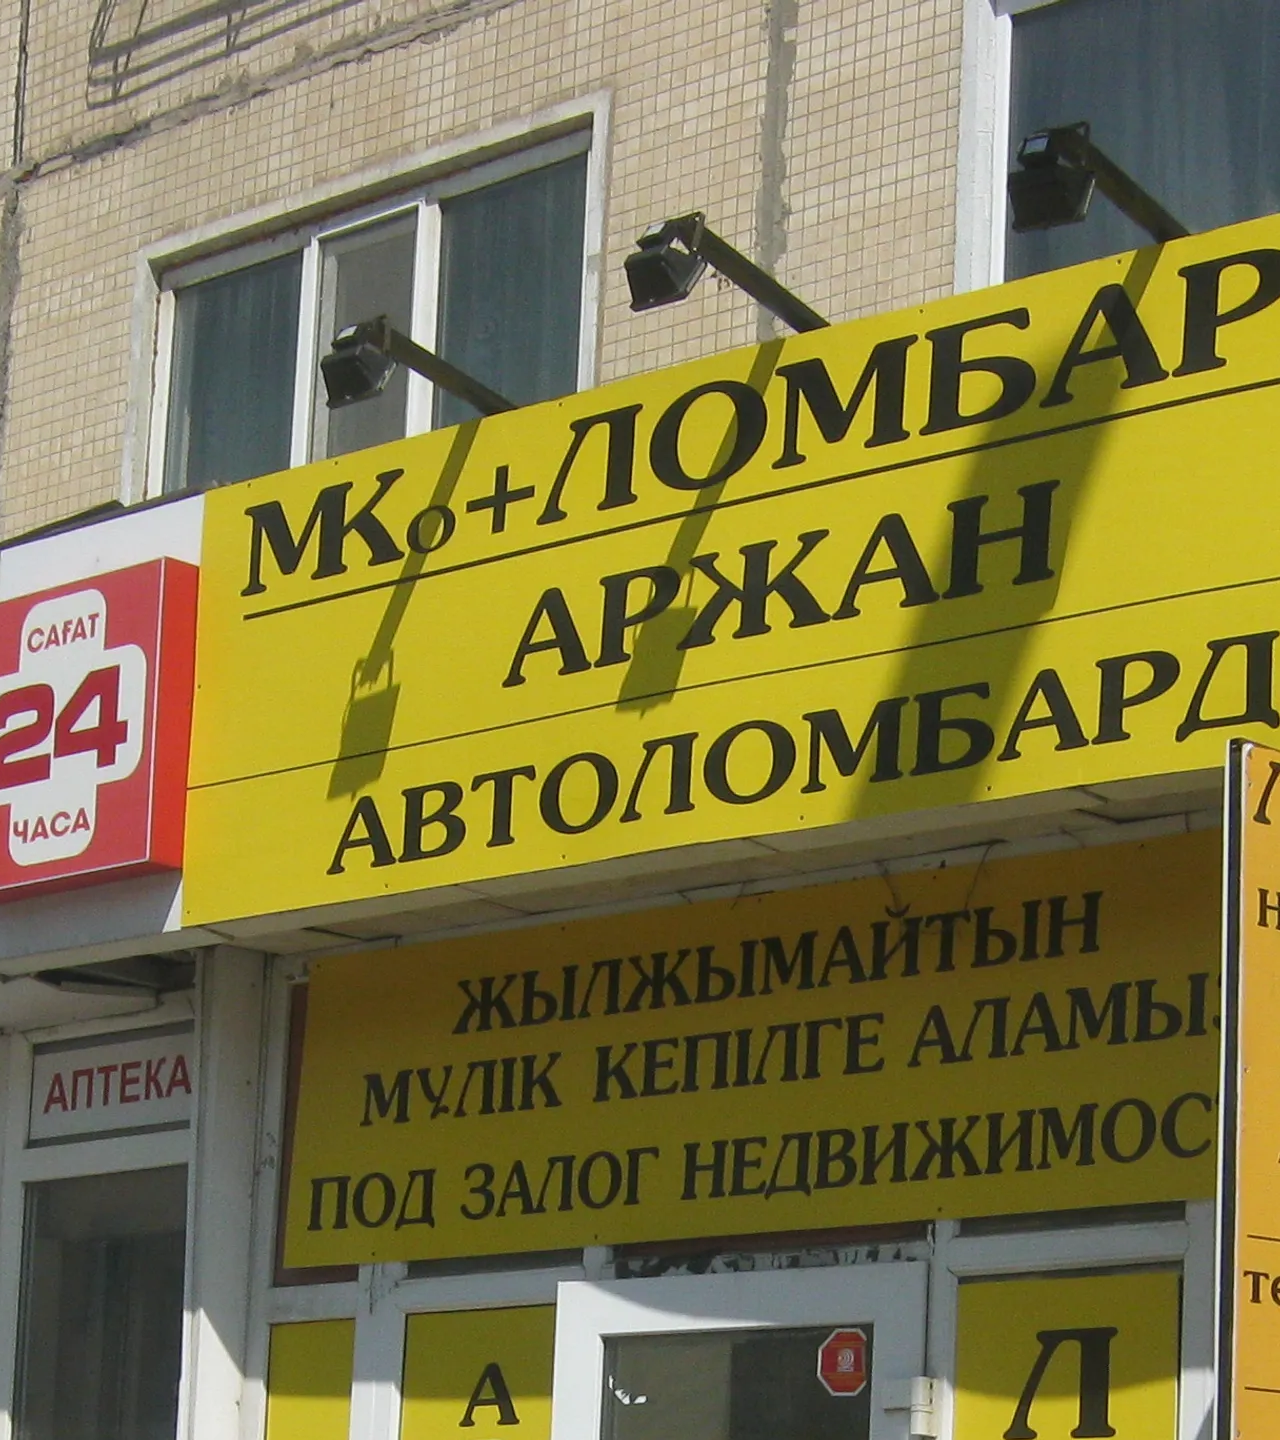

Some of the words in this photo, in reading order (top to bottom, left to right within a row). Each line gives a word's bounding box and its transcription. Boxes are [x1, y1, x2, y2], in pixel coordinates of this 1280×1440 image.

[27, 613, 100, 653] САҒАТ
[503, 479, 1060, 687] АРЖАН
[327, 630, 1280, 875] АВТОЛОМБАРД
[13, 807, 91, 843] ЧАСА
[452, 891, 1102, 1034] ЖЫЛЖЫМАЙТЫН
[43, 1054, 192, 1114] АПТЕКА
[593, 1012, 883, 1103] КЕПІЛГЕ
[907, 973, 1221, 1067] АЛАМЫ
[307, 1169, 435, 1231] ПОД
[460, 1147, 659, 1221] ЗАЛОГ
[680, 1091, 1221, 1199] НЕДВИЖИМОС
